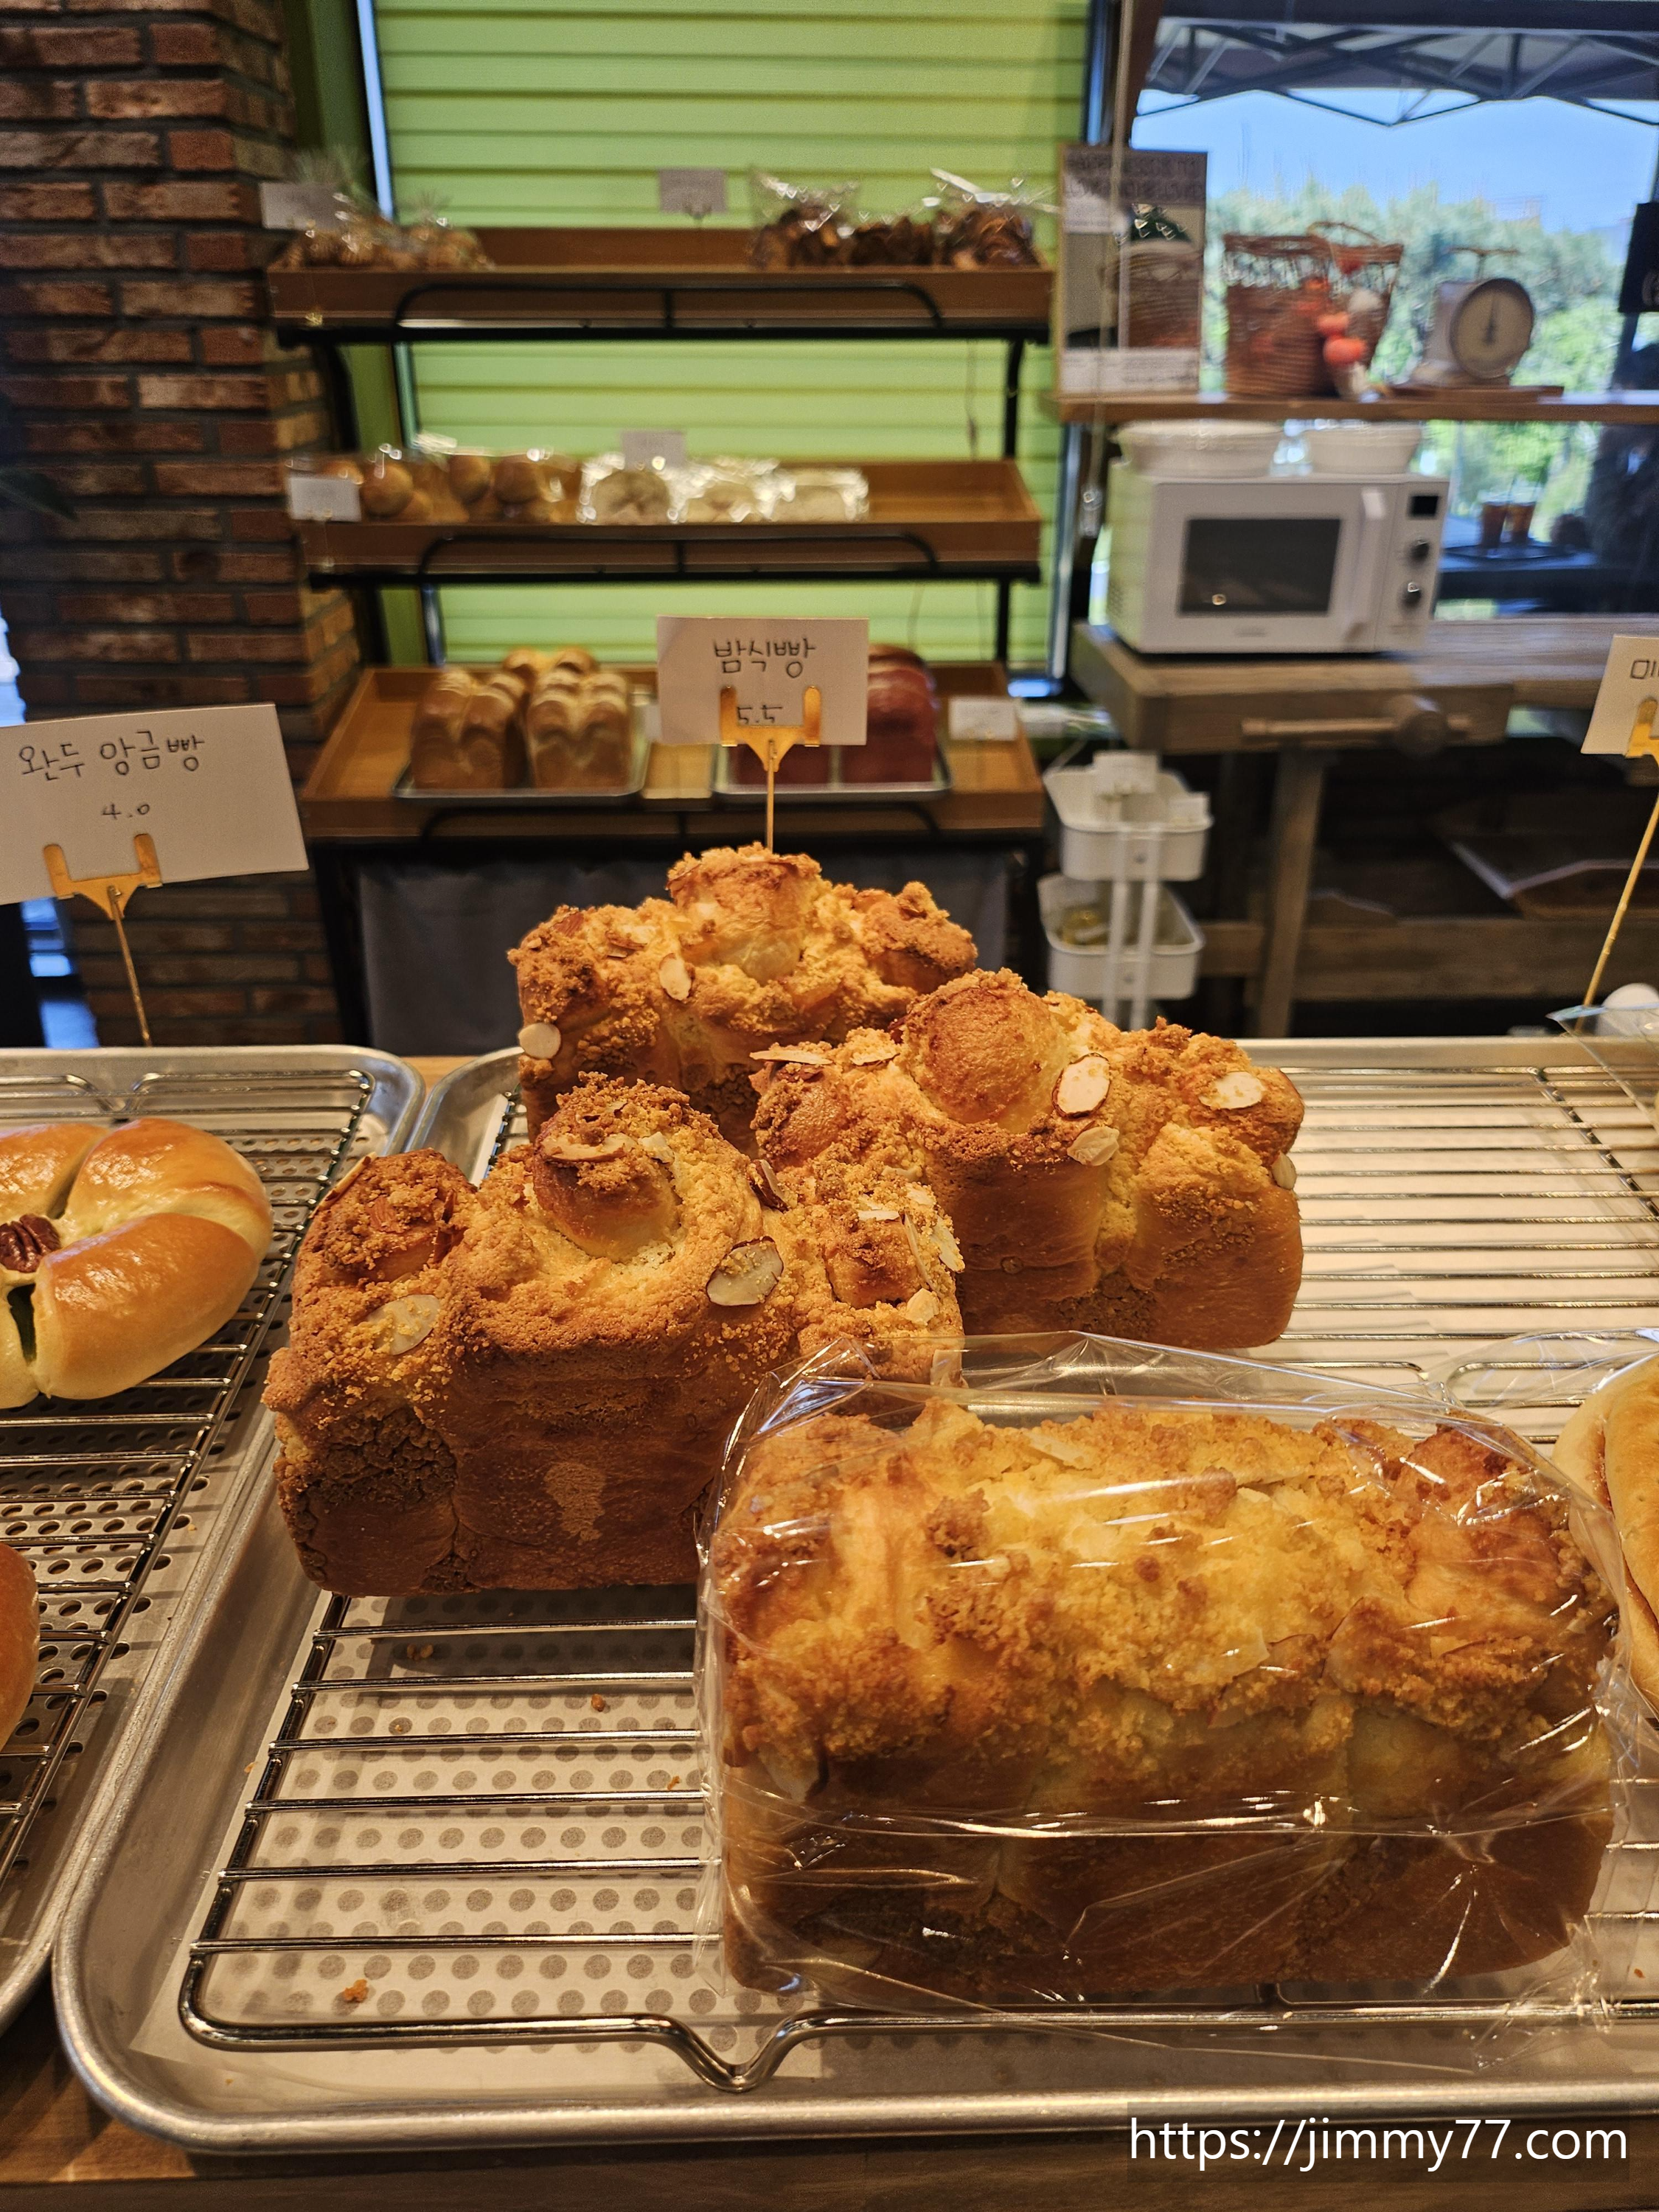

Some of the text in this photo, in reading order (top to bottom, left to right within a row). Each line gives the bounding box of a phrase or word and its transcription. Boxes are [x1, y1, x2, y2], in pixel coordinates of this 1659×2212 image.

[713, 637, 815, 678] 밤식빵
[1630, 659, 1659, 679] 미
[737, 704, 783, 724] 5.5
[18, 743, 85, 781] 완두
[101, 803, 150, 820] 4.0
